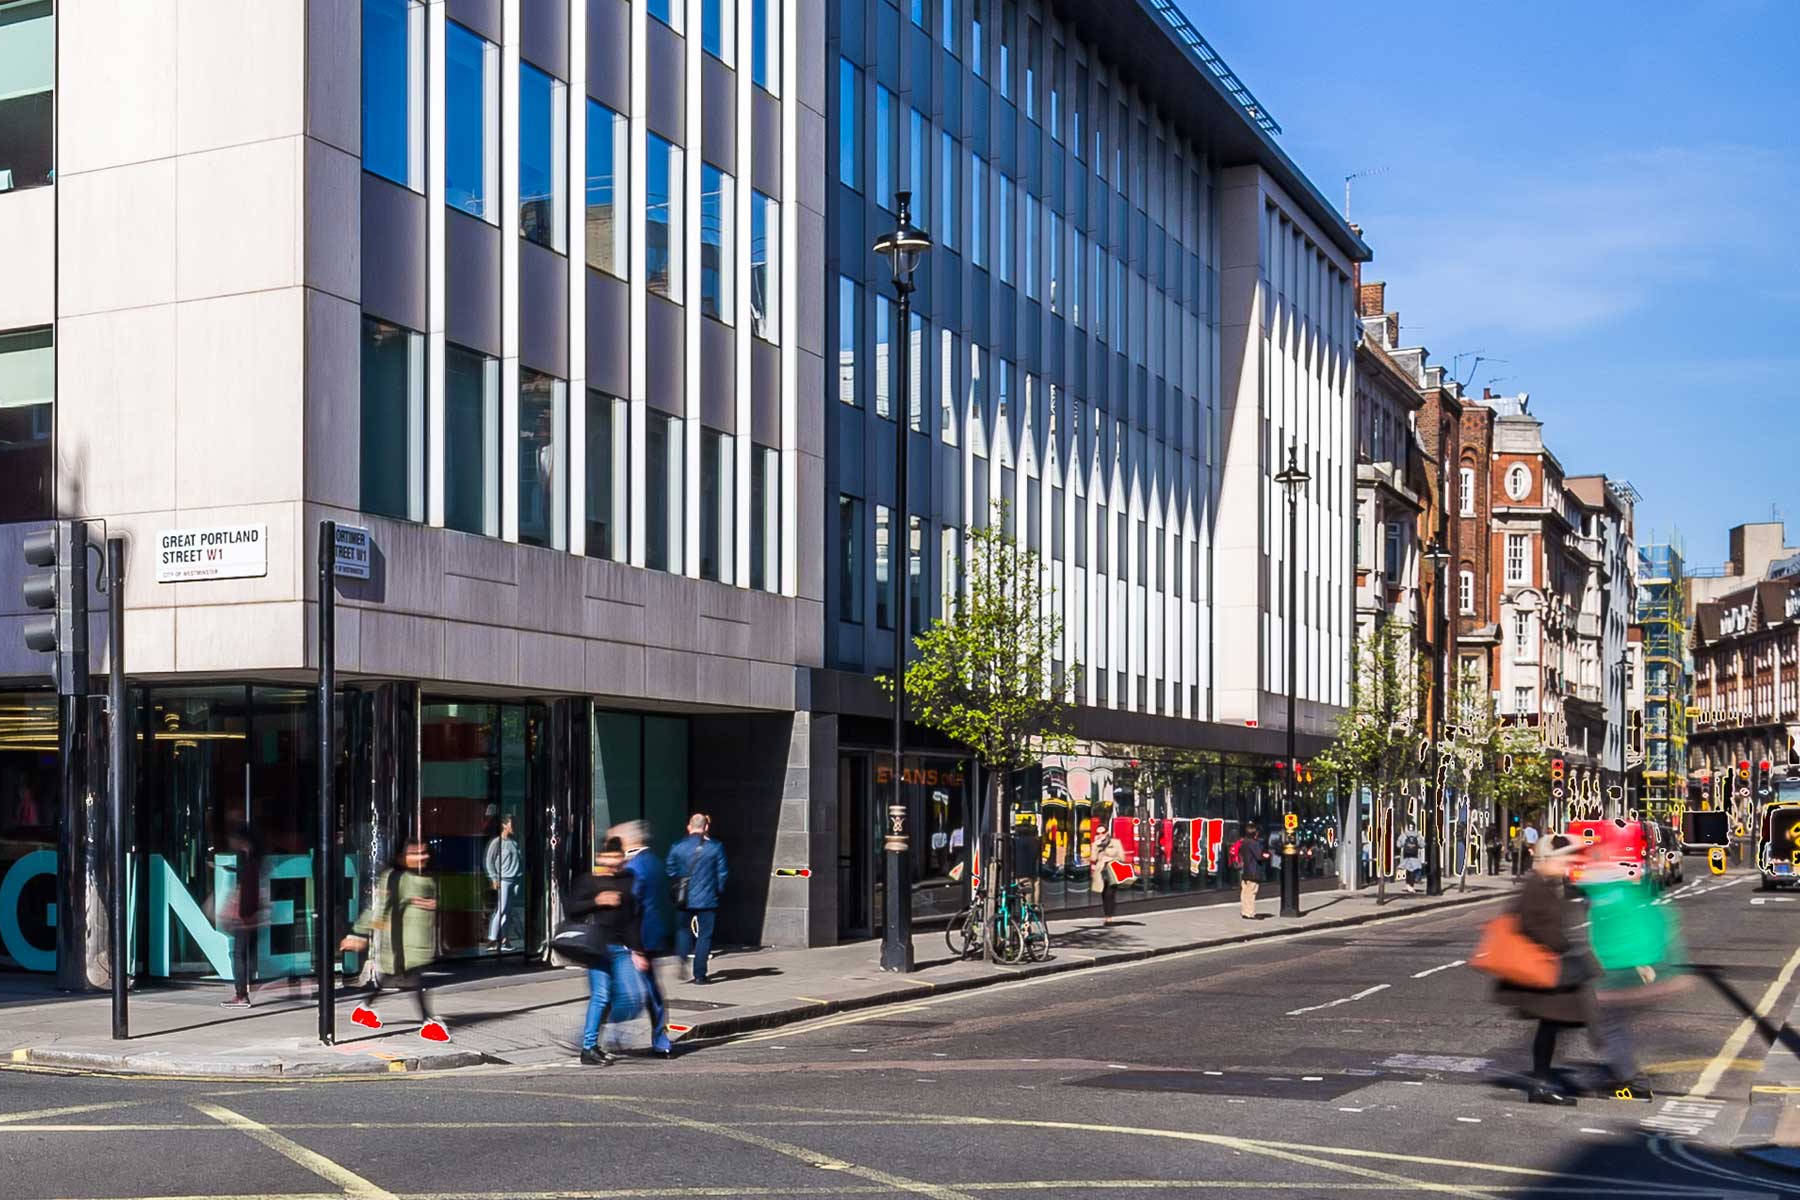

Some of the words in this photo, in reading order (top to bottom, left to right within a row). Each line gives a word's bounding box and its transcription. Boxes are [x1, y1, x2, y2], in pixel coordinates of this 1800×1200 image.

[162, 534, 196, 548] GREAT
[200, 529, 259, 546] PORTLAND
[335, 528, 366, 546] ORTIMER
[162, 549, 202, 564] STREET
[207, 549, 223, 560] W1
